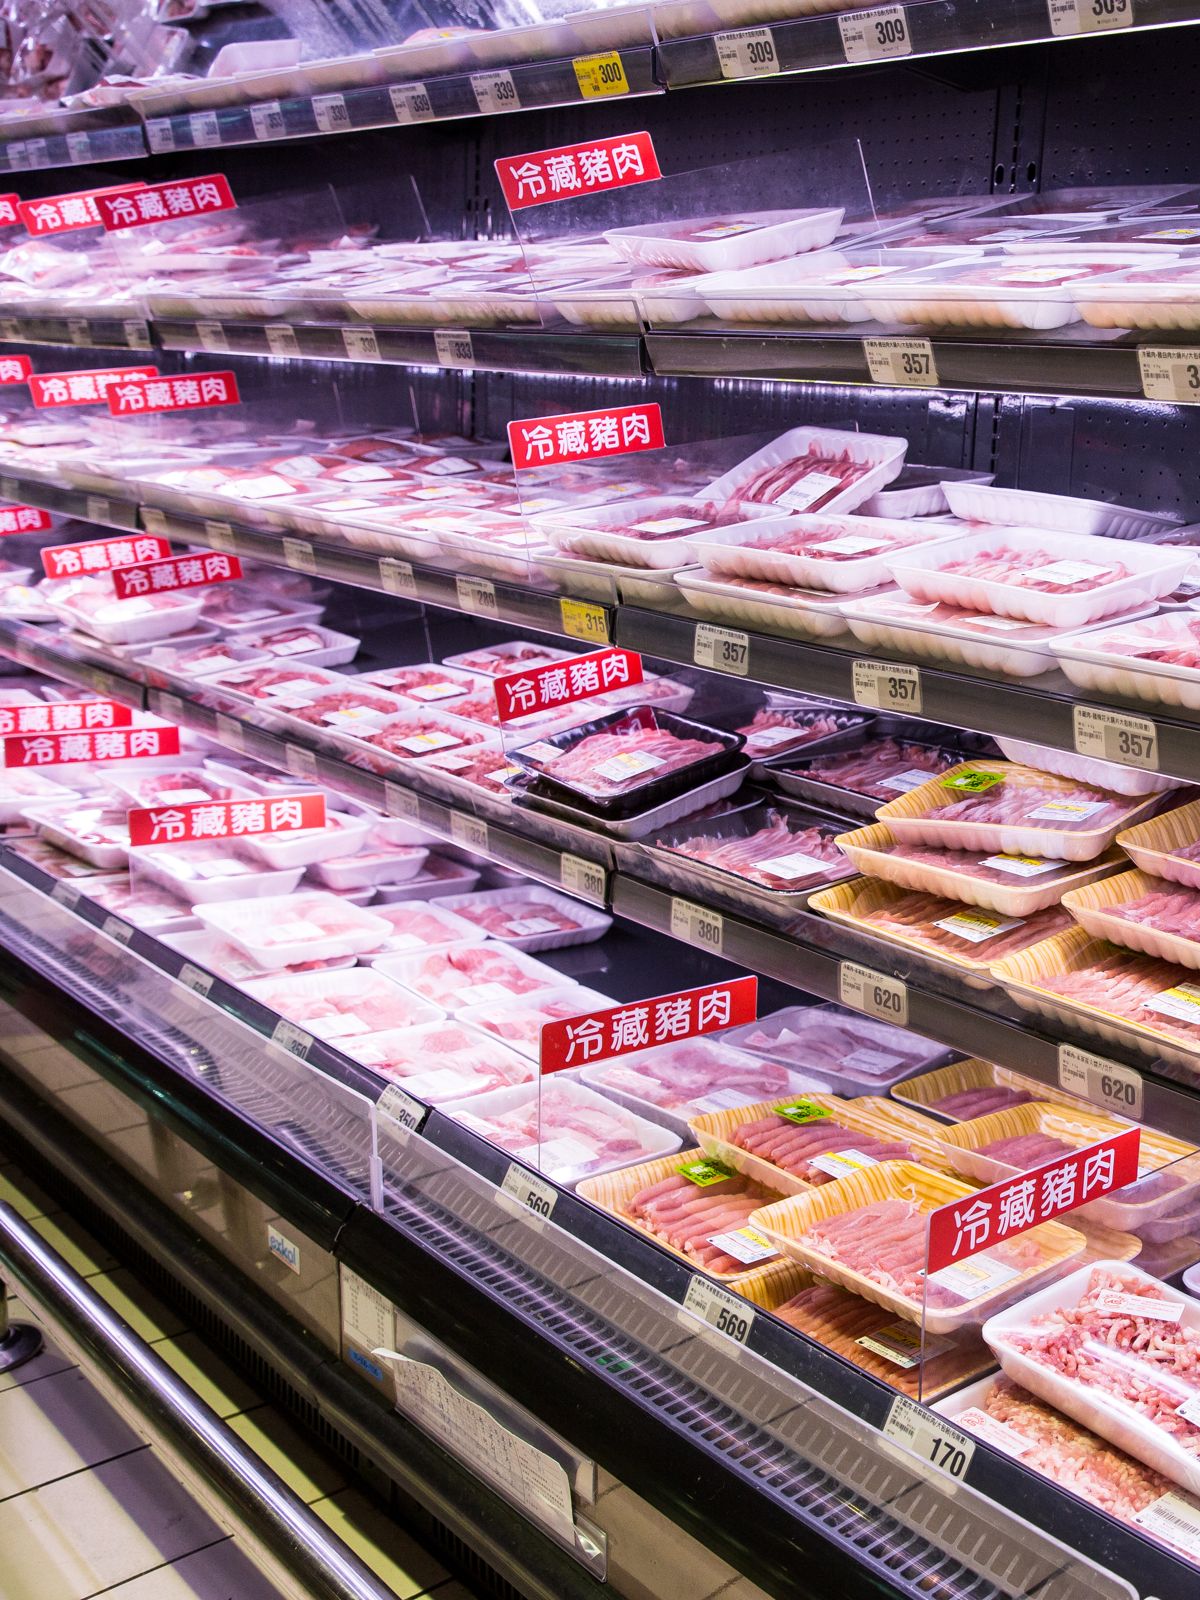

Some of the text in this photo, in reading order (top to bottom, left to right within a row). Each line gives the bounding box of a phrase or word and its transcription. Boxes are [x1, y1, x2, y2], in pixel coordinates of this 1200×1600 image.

[875, 18, 905, 45] 309
[747, 40, 774, 64] 309
[599, 61, 622, 84] 300
[412, 94, 430, 112] 339
[494, 80, 515, 100] 339
[509, 143, 645, 199] 冷藏豬肉
[29, 196, 102, 230] 冷藏
[105, 182, 222, 225] 冷藏豬肉
[902, 353, 929, 374] 357
[115, 378, 228, 410] 冷藏豬肉
[521, 412, 650, 461] 冷藏豬肉
[52, 538, 161, 574] 冷藏豬肉
[121, 555, 231, 594] 冷藏豬肉
[586, 613, 605, 633] 315
[723, 641, 747, 664] 357
[505, 653, 629, 713] 冷藏豬肉
[888, 677, 917, 700] 357
[22, 730, 159, 764] 冷藏豬肉
[1119, 731, 1154, 759] 357
[150, 800, 302, 842] 冷藏豬肉
[584, 872, 603, 894] 380
[698, 919, 720, 945] 380
[874, 986, 901, 1013] 620
[565, 990, 731, 1062] 冷藏豬肉
[1101, 1075, 1136, 1106] 620
[398, 1104, 415, 1129] 350
[526, 1191, 550, 1218] 569
[951, 1148, 1115, 1256] 冷藏豬肉
[716, 1307, 747, 1342] 569
[929, 1437, 966, 1477] 170
